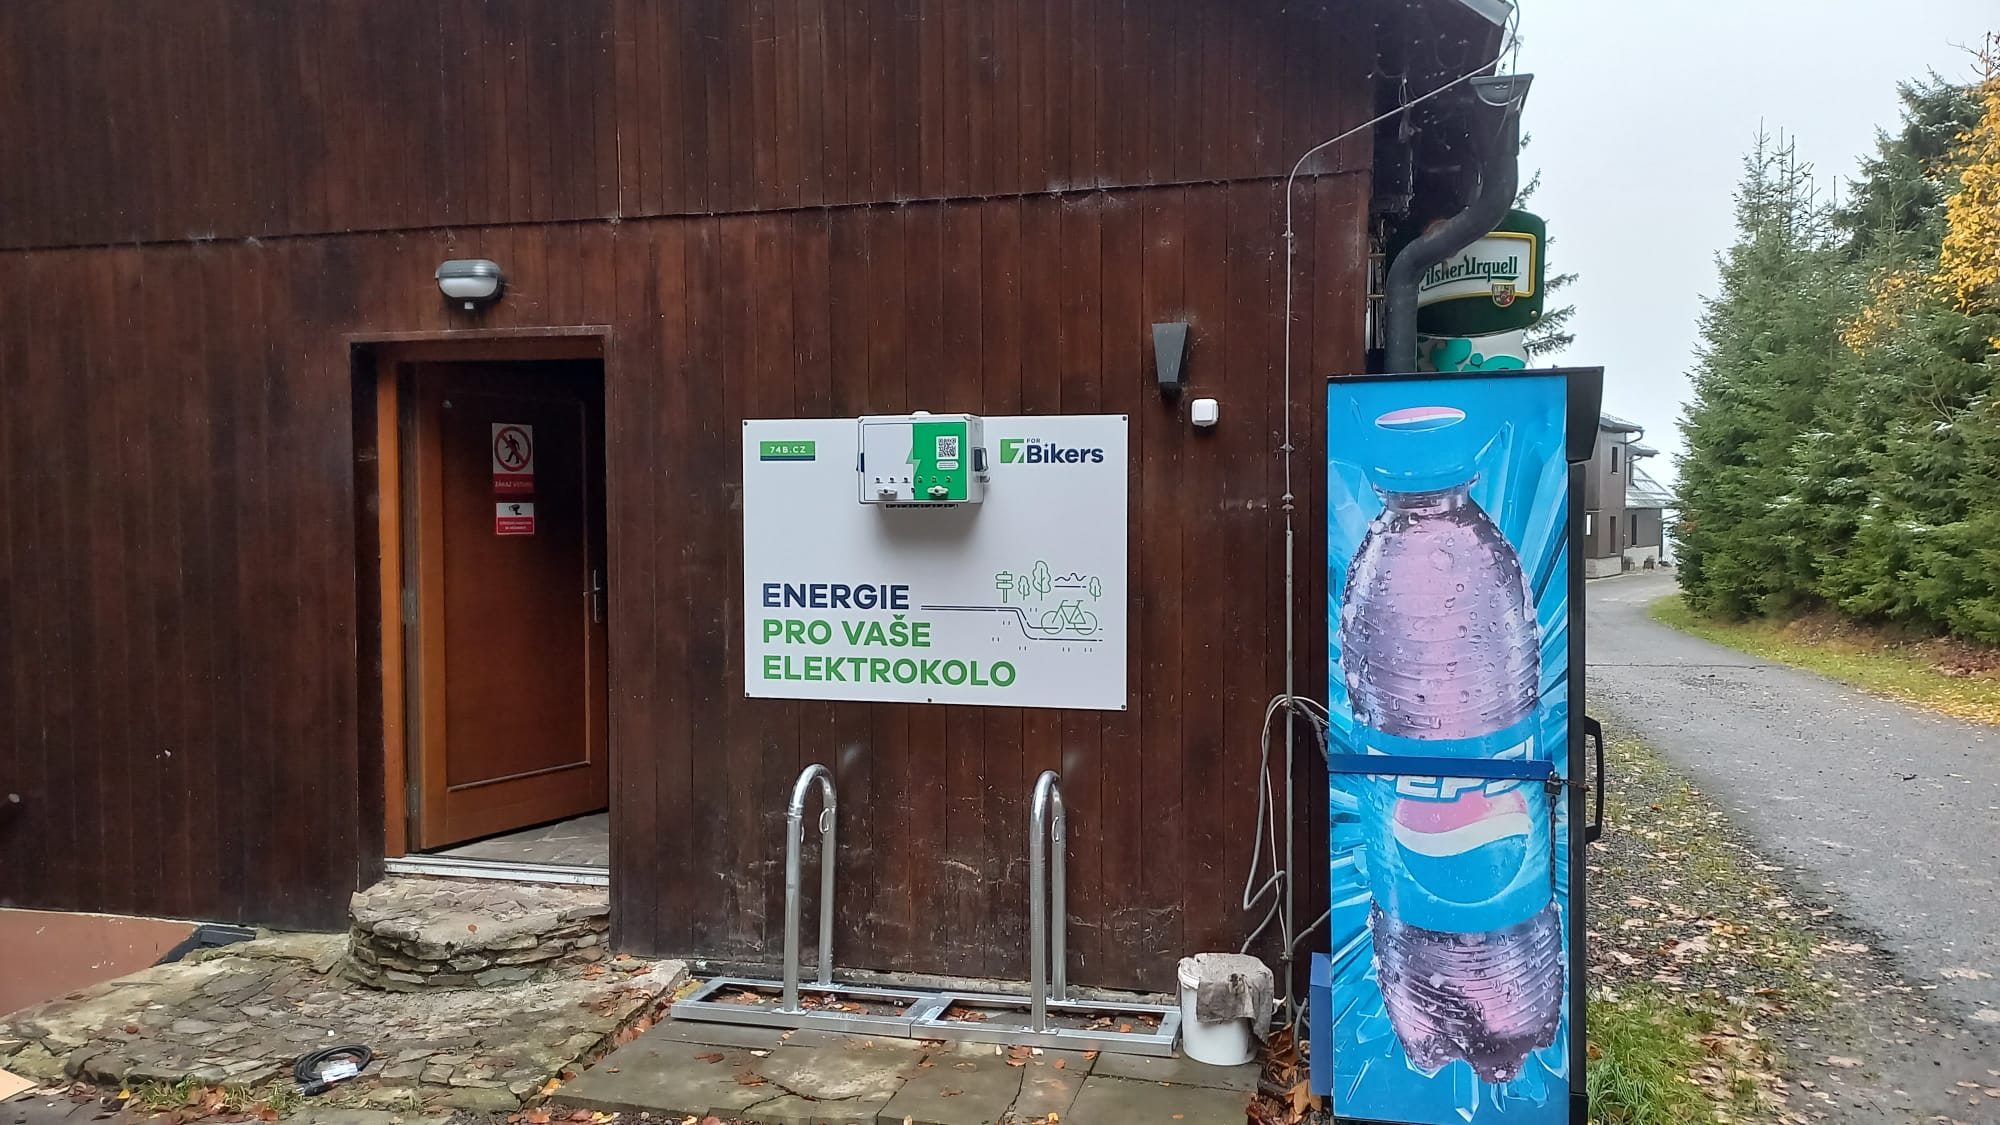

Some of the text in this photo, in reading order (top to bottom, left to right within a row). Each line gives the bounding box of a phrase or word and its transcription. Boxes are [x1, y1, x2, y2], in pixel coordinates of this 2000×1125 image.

[1424, 255, 1517, 286] ilsner Urquell
[769, 445, 807, 454] 74B.CZ
[1026, 443, 1104, 464] Bikers
[762, 583, 910, 610] ENERGIE
[762, 614, 932, 647] PRO VAŠE
[763, 655, 1016, 686] ELEKTROKOLO
